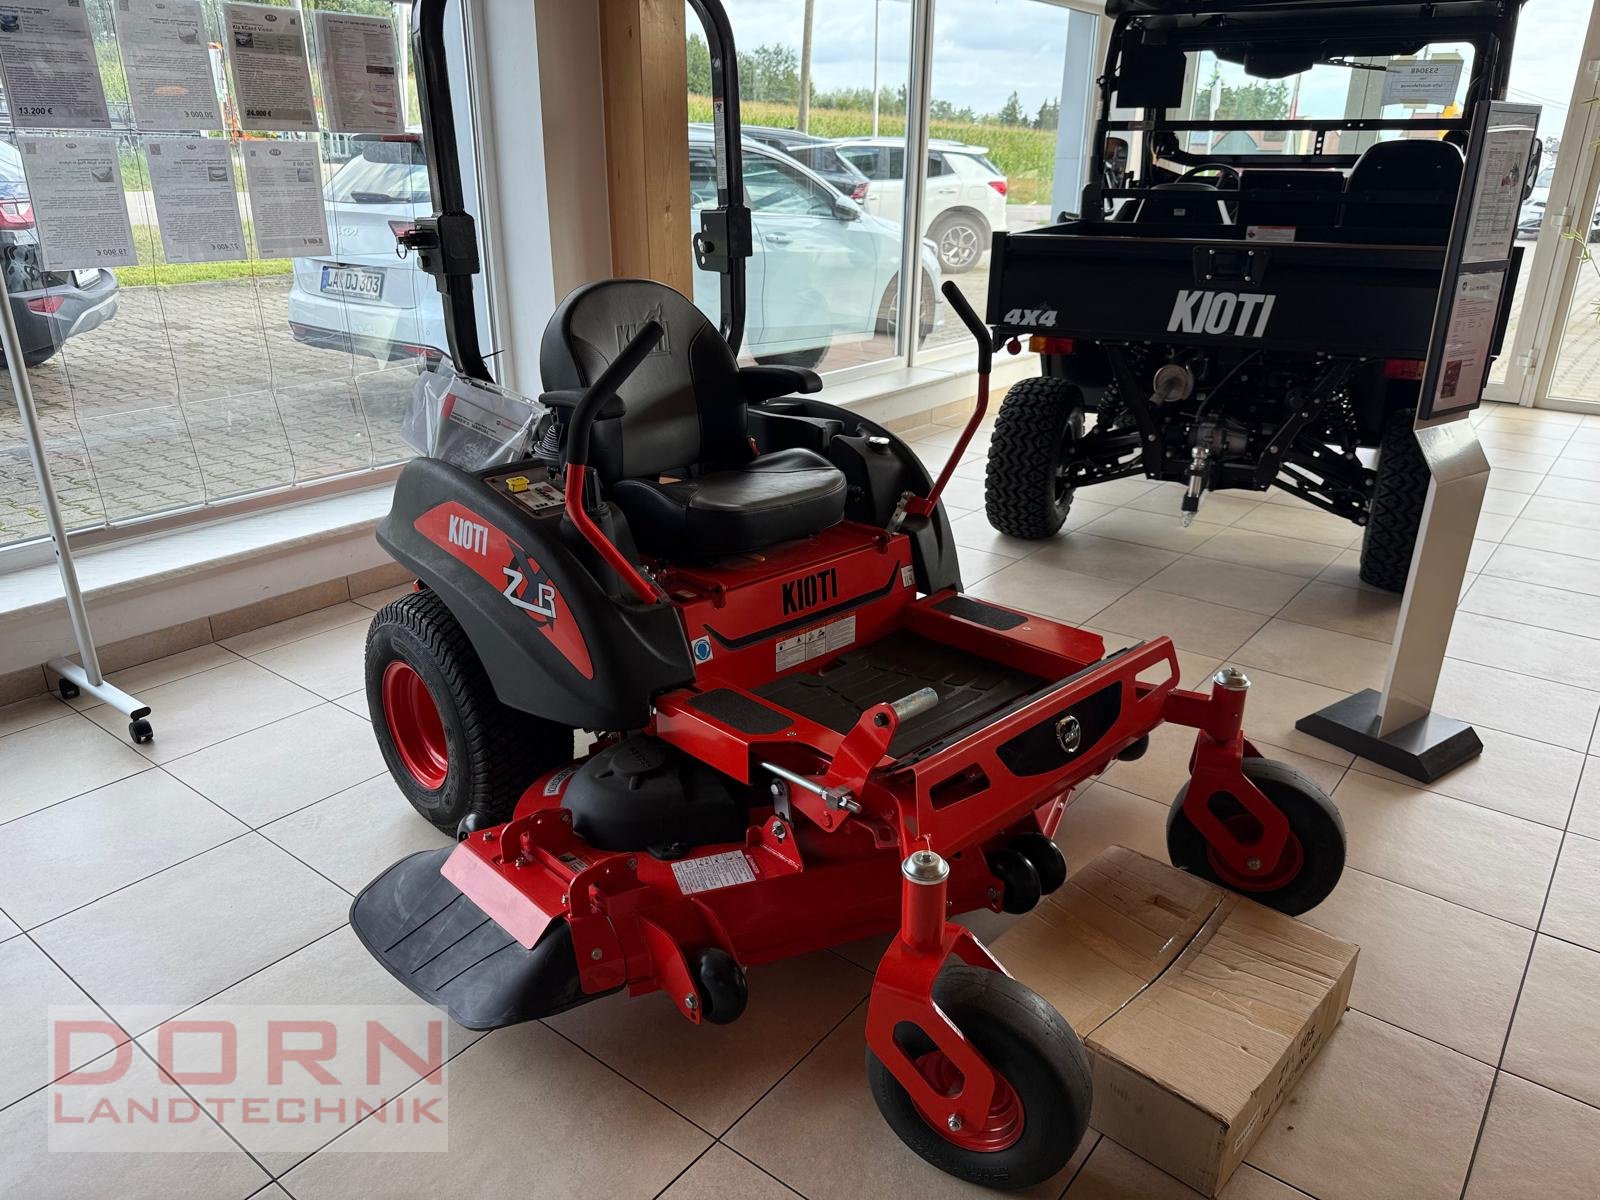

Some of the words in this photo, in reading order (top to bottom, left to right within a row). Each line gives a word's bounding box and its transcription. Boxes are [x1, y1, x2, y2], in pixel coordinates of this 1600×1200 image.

[19, 107, 46, 116] 13.200
[47, 107, 53, 115] €
[246, 109, 265, 117] 24.900
[345, 273, 358, 290] DJ
[360, 275, 380, 293] 303
[1003, 308, 1058, 328] 4X4
[1167, 289, 1275, 338] KIOTI
[448, 514, 489, 557] KIOTI
[782, 568, 838, 616] KIOTI
